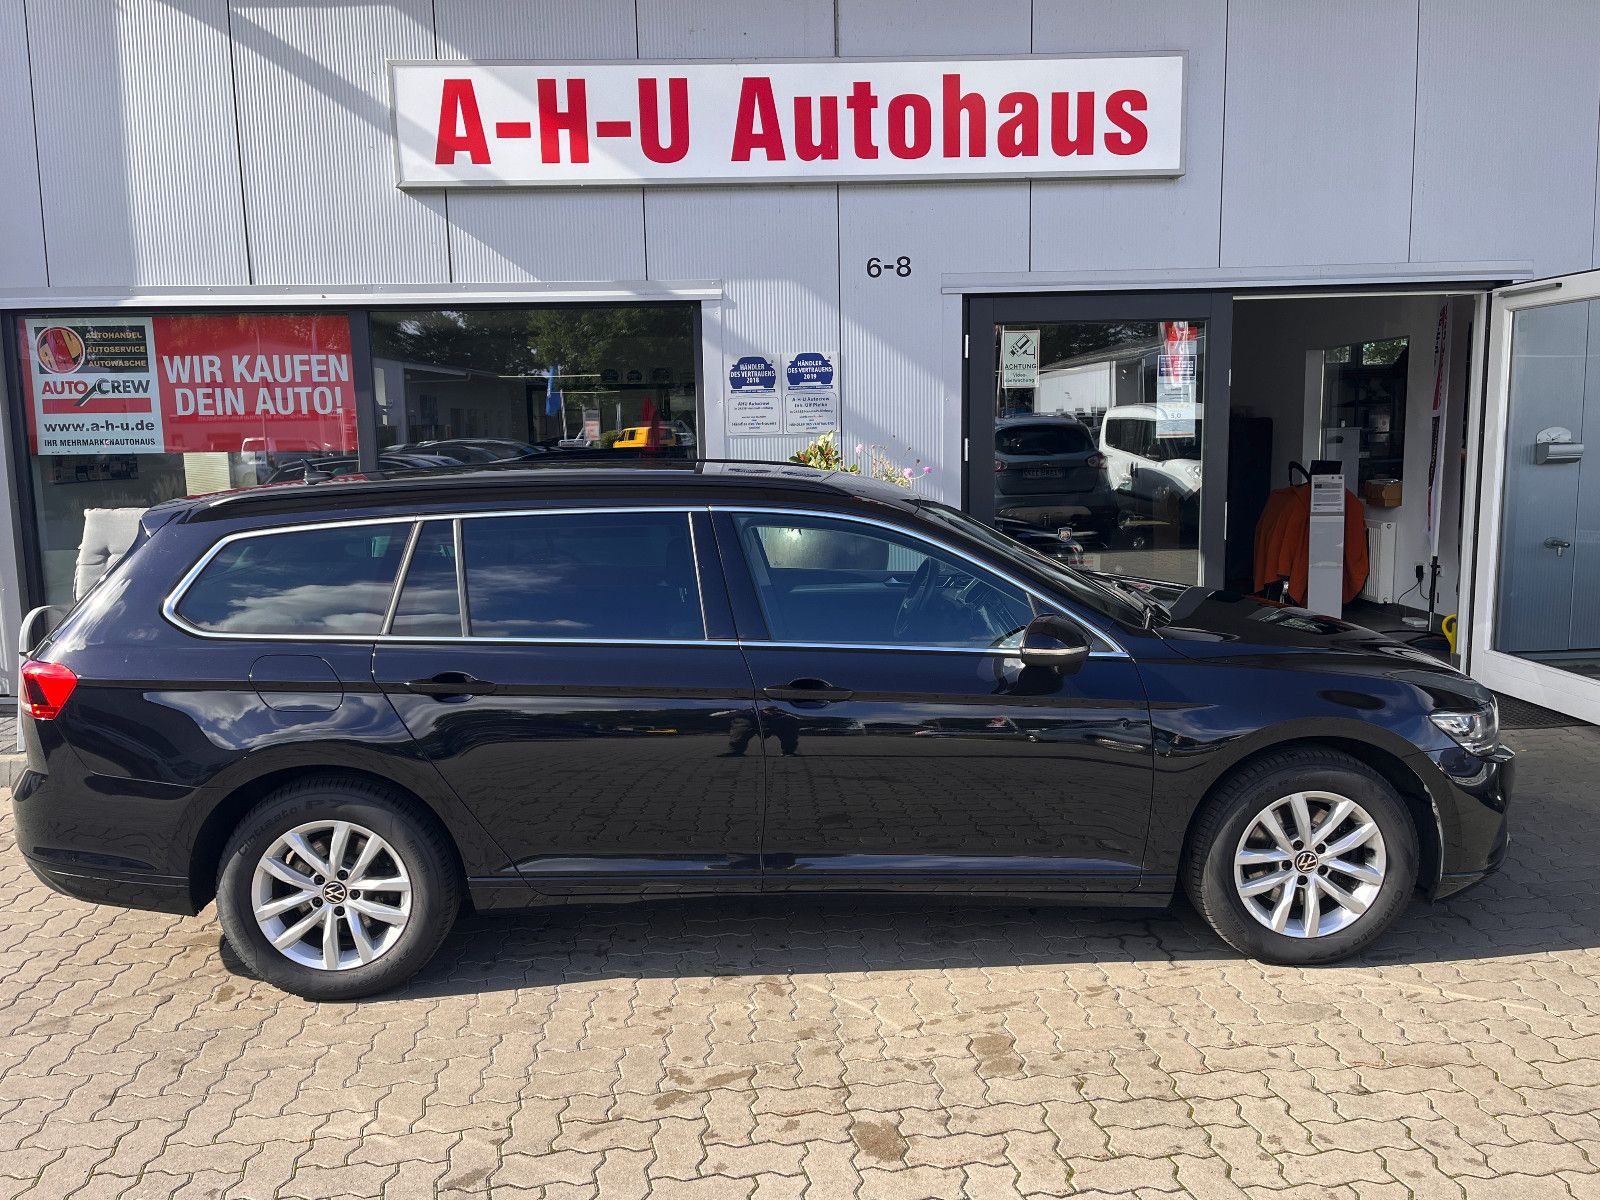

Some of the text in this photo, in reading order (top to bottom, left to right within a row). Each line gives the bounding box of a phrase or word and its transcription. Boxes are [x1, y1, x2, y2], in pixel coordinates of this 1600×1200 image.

[435, 74, 1148, 165] A-H-U Autohaus
[867, 256, 911, 278] 6-8
[85, 331, 142, 339] AUTOHANDEL
[162, 354, 349, 384] WIR KAUFEN
[174, 386, 343, 416] DEIN AUTO!
[44, 420, 155, 432] www.a-h-u.de
[44, 438, 156, 447] IHR MEHRMARKENAUTOHAUS
